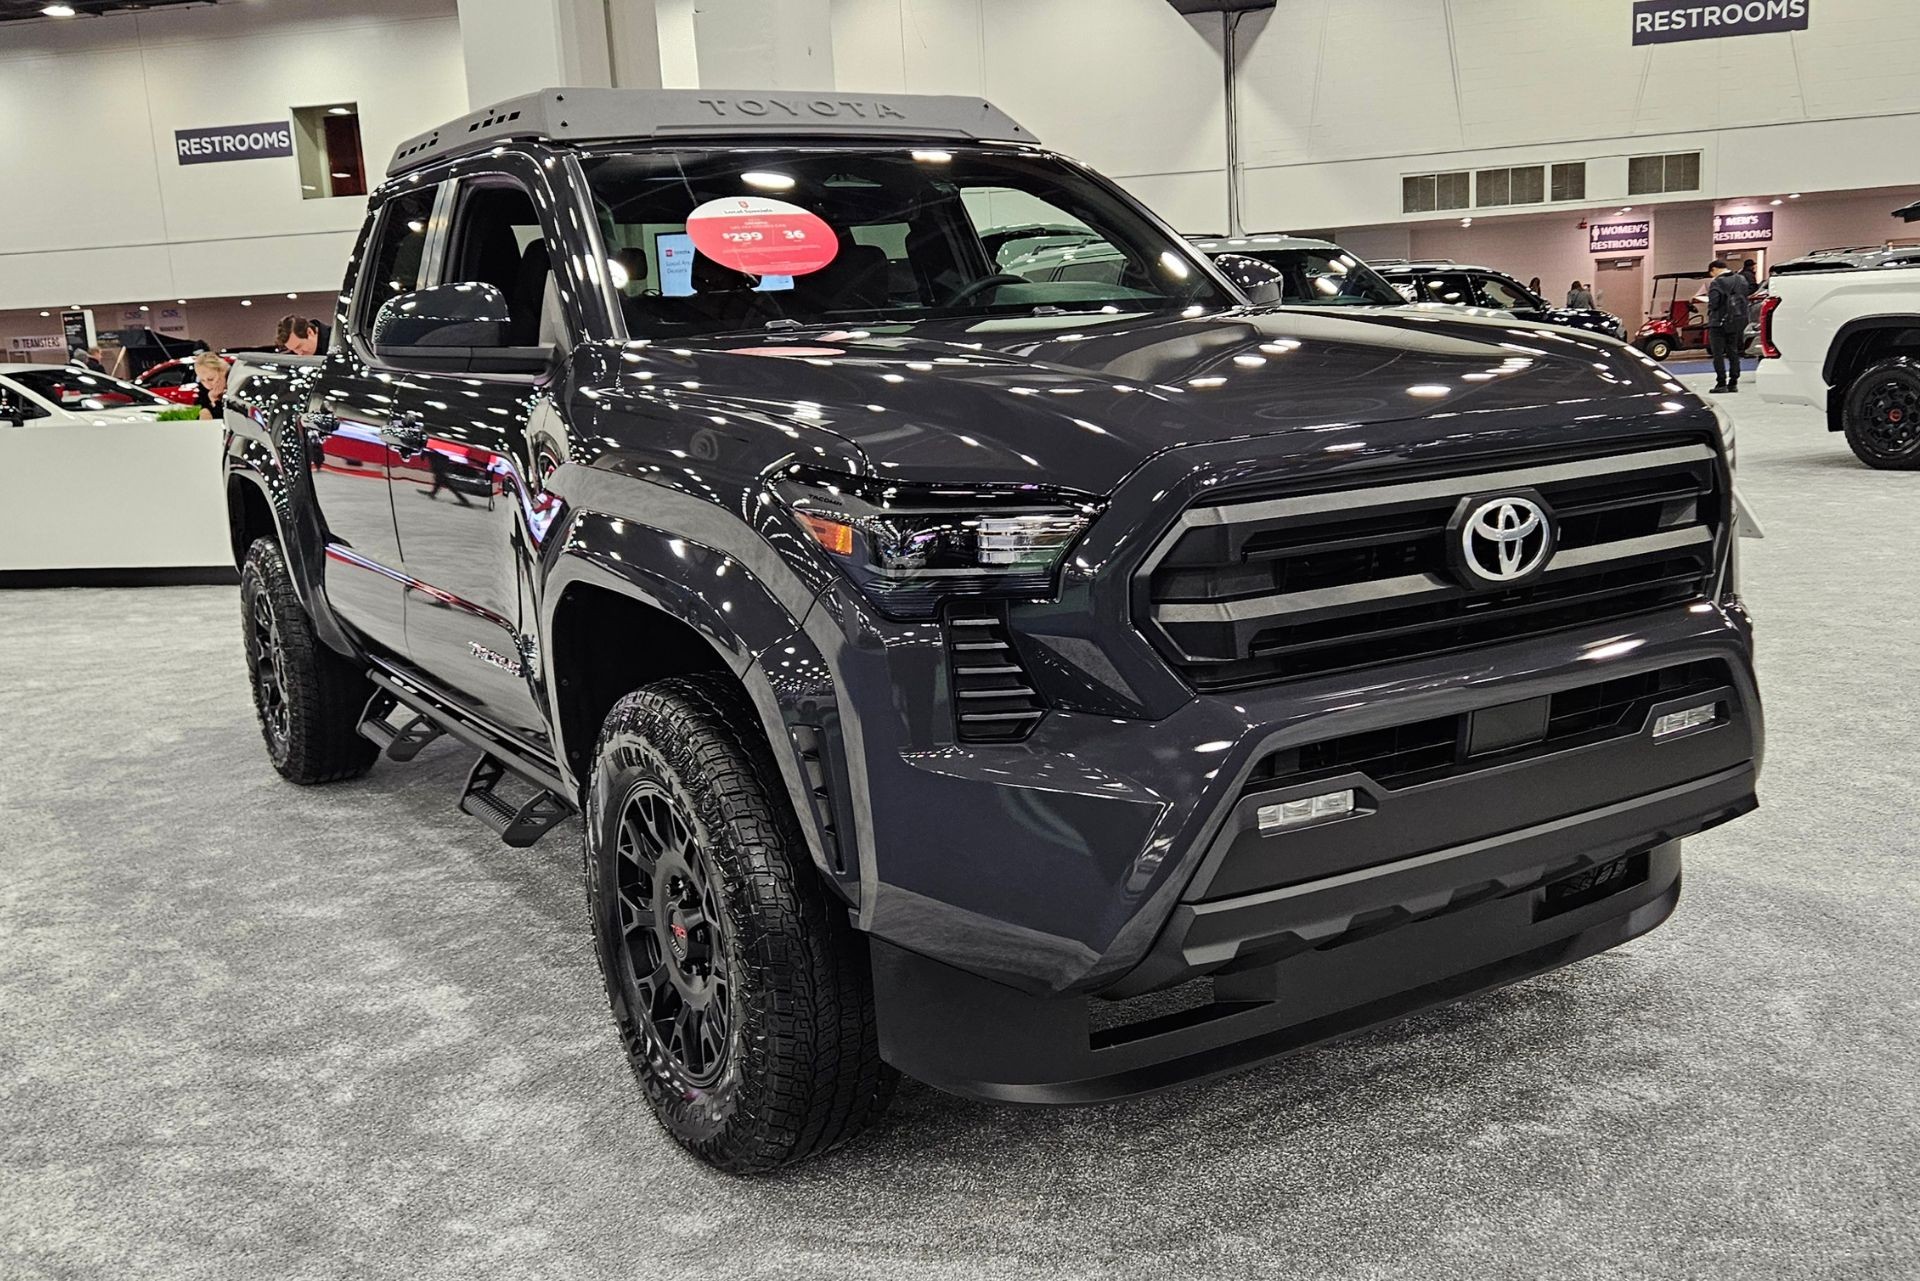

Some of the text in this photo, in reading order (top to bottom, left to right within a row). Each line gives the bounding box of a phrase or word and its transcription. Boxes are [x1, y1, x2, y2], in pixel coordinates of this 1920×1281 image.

[1635, 0, 1806, 33] RESTROOMS
[698, 99, 906, 119] TOYOTA
[177, 130, 291, 156] RESTROOMS
[1725, 215, 1760, 226] MEN'S
[782, 230, 806, 240] 36
[1600, 223, 1649, 236] WOMEN'S
[1713, 229, 1772, 241] RESTROOMS
[1590, 238, 1648, 250] RESTROOMS
